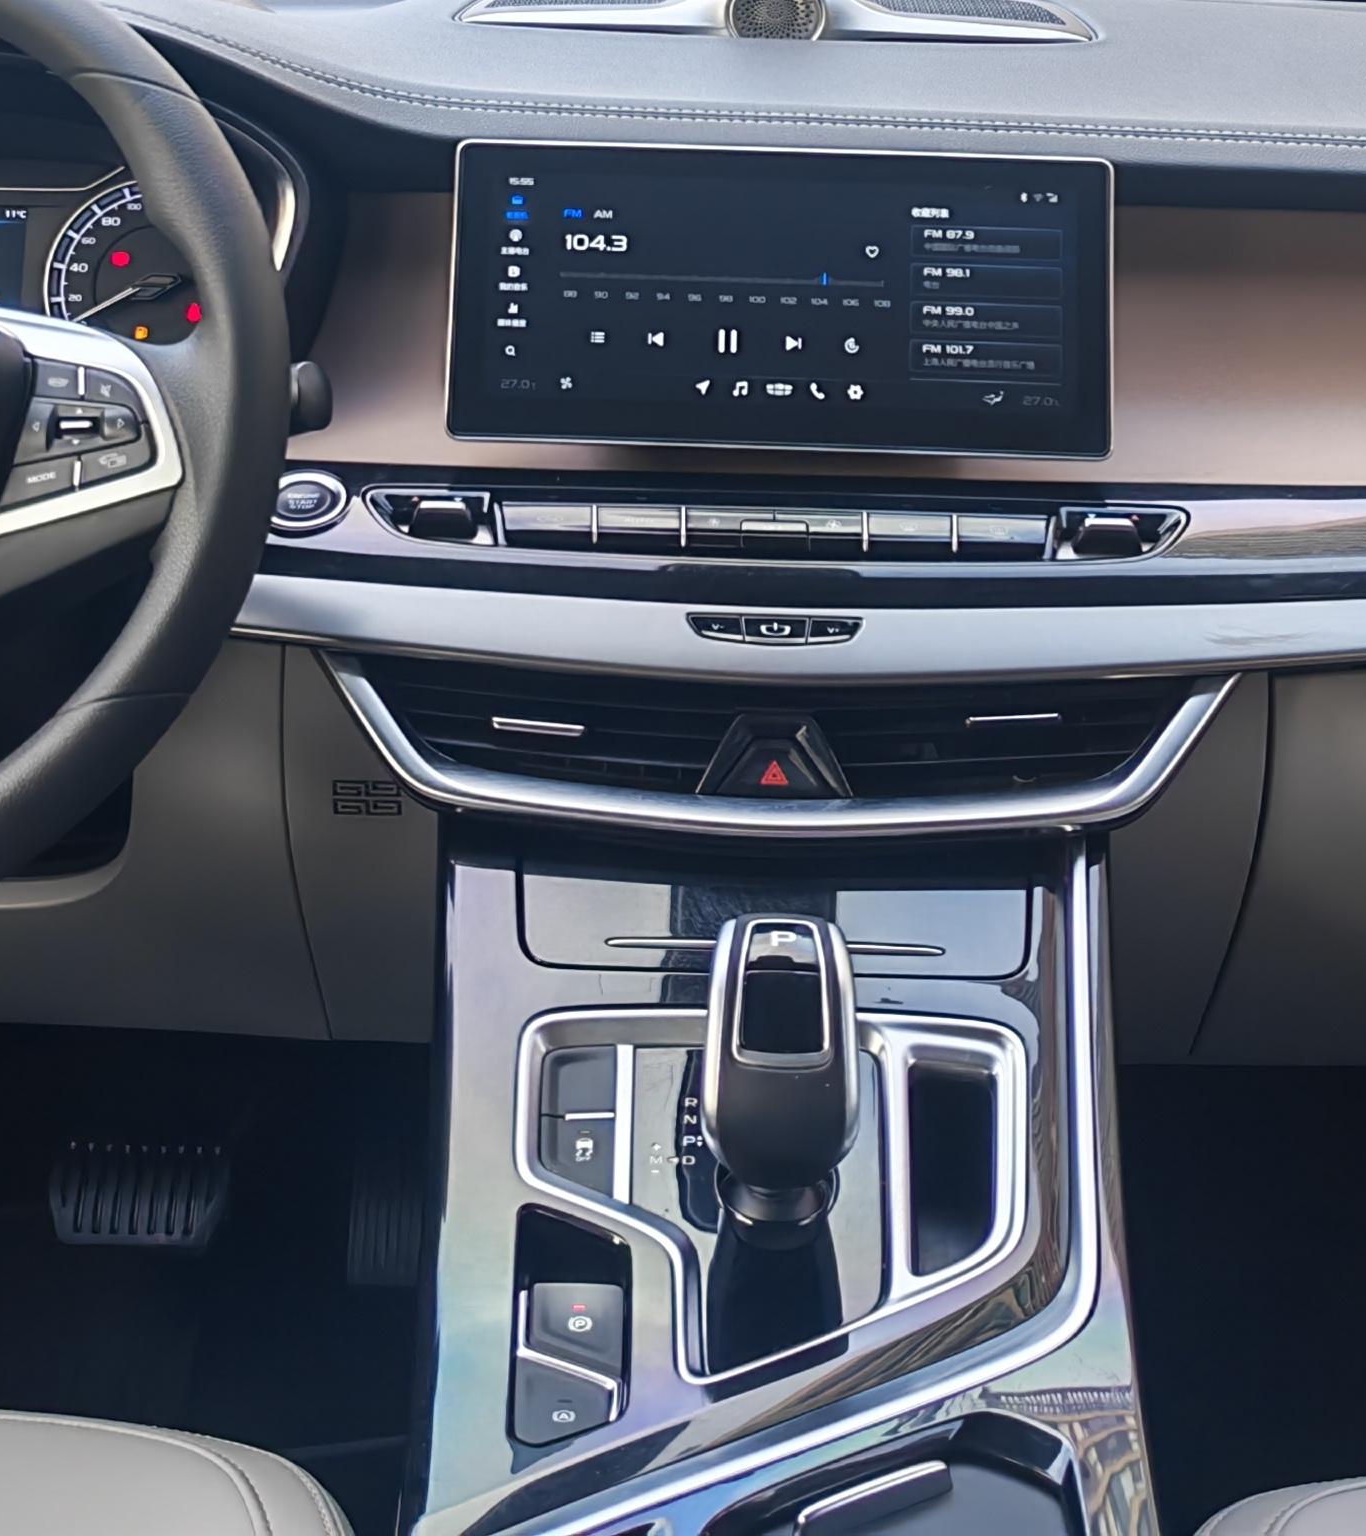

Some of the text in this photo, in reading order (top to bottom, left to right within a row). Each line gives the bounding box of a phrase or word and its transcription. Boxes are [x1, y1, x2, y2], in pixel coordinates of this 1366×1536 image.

[563, 208, 613, 219] FM AM
[101, 217, 121, 227] 80
[923, 229, 942, 239] FM
[81, 237, 96, 245] 60
[565, 233, 628, 252] 104.3
[69, 263, 89, 273] 40
[923, 267, 942, 277] FM
[68, 294, 83, 303] 20
[594, 291, 608, 299] 90
[656, 293, 671, 301] 94
[688, 294, 702, 302] 96
[719, 295, 733, 303] 98
[749, 296, 766, 304] 100
[780, 296, 797, 305] 102
[811, 298, 828, 306] 104
[842, 298, 860, 307] 106
[922, 305, 975, 316] FM 99.0
[922, 344, 974, 355] FM 101.7
[26, 471, 57, 484] MODE
[770, 932, 797, 948] P
[684, 1097, 698, 1108] R
[683, 1115, 697, 1125] N
[682, 1136, 696, 1147] P
[649, 1155, 696, 1165] M D
